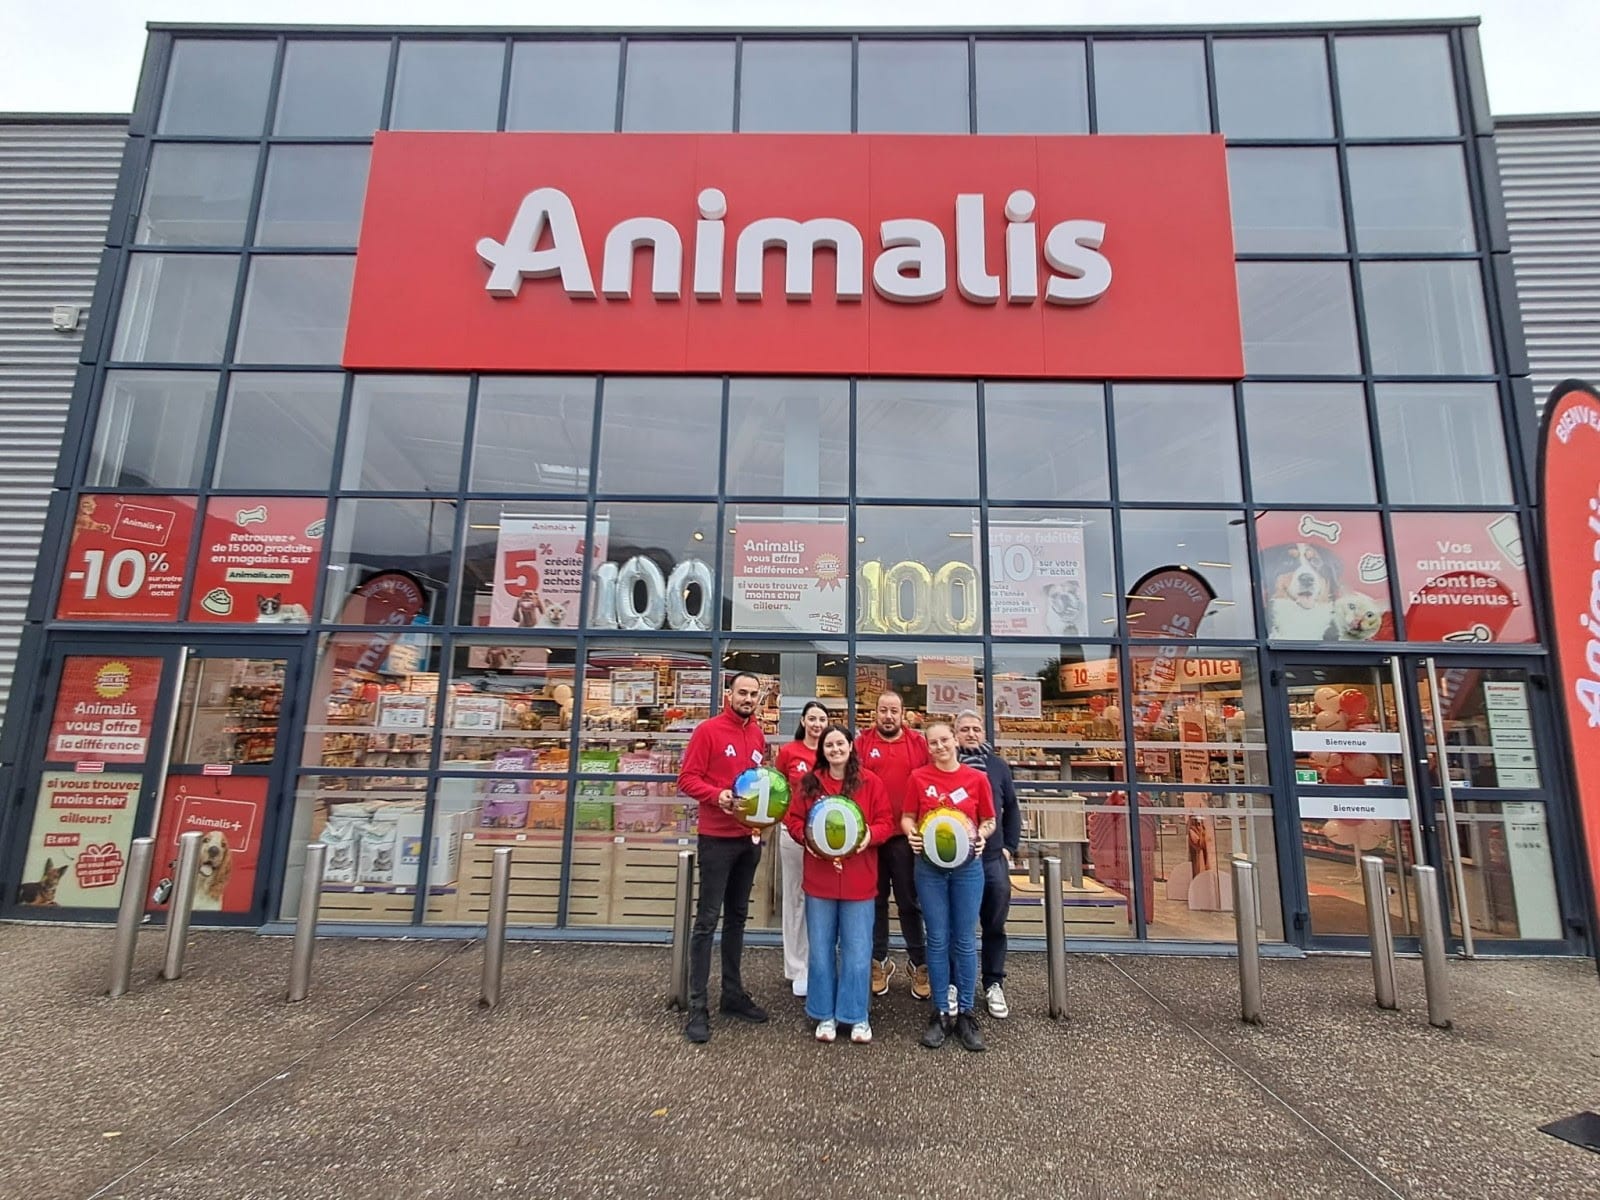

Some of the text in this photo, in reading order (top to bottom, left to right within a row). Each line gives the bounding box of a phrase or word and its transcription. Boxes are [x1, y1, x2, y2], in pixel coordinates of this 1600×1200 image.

[475, 187, 1112, 305] Animalis
[1555, 405, 1600, 444] BIENVE
[230, 533, 287, 542] Retrouvez
[212, 543, 313, 555] de 15 000 produits
[743, 540, 805, 552] Animalis
[1437, 541, 1472, 553] Vos
[228, 554, 279, 565] magasin
[280, 555, 289, 563] &
[291, 556, 312, 564] sur
[774, 555, 798, 563] offre
[1417, 558, 1501, 571] animaux
[229, 571, 290, 579] Animalis.com
[149, 582, 181, 590] premier
[543, 577, 581, 586] achats
[738, 581, 746, 589] si
[772, 582, 808, 590] trouvez
[1426, 575, 1497, 588] sont les
[746, 591, 776, 599] moins
[858, 560, 980, 635] 100
[1409, 590, 1508, 606] bienvenus
[74, 701, 137, 715] Animalis
[66, 720, 138, 734] vous offre
[60, 738, 141, 750] la différence
[1325, 738, 1367, 747] Bienvenue
[47, 779, 140, 791] si vous trouvez
[53, 794, 93, 805] moins
[1333, 804, 1376, 813] Bienvenue
[745, 775, 970, 869] 1 0 0
